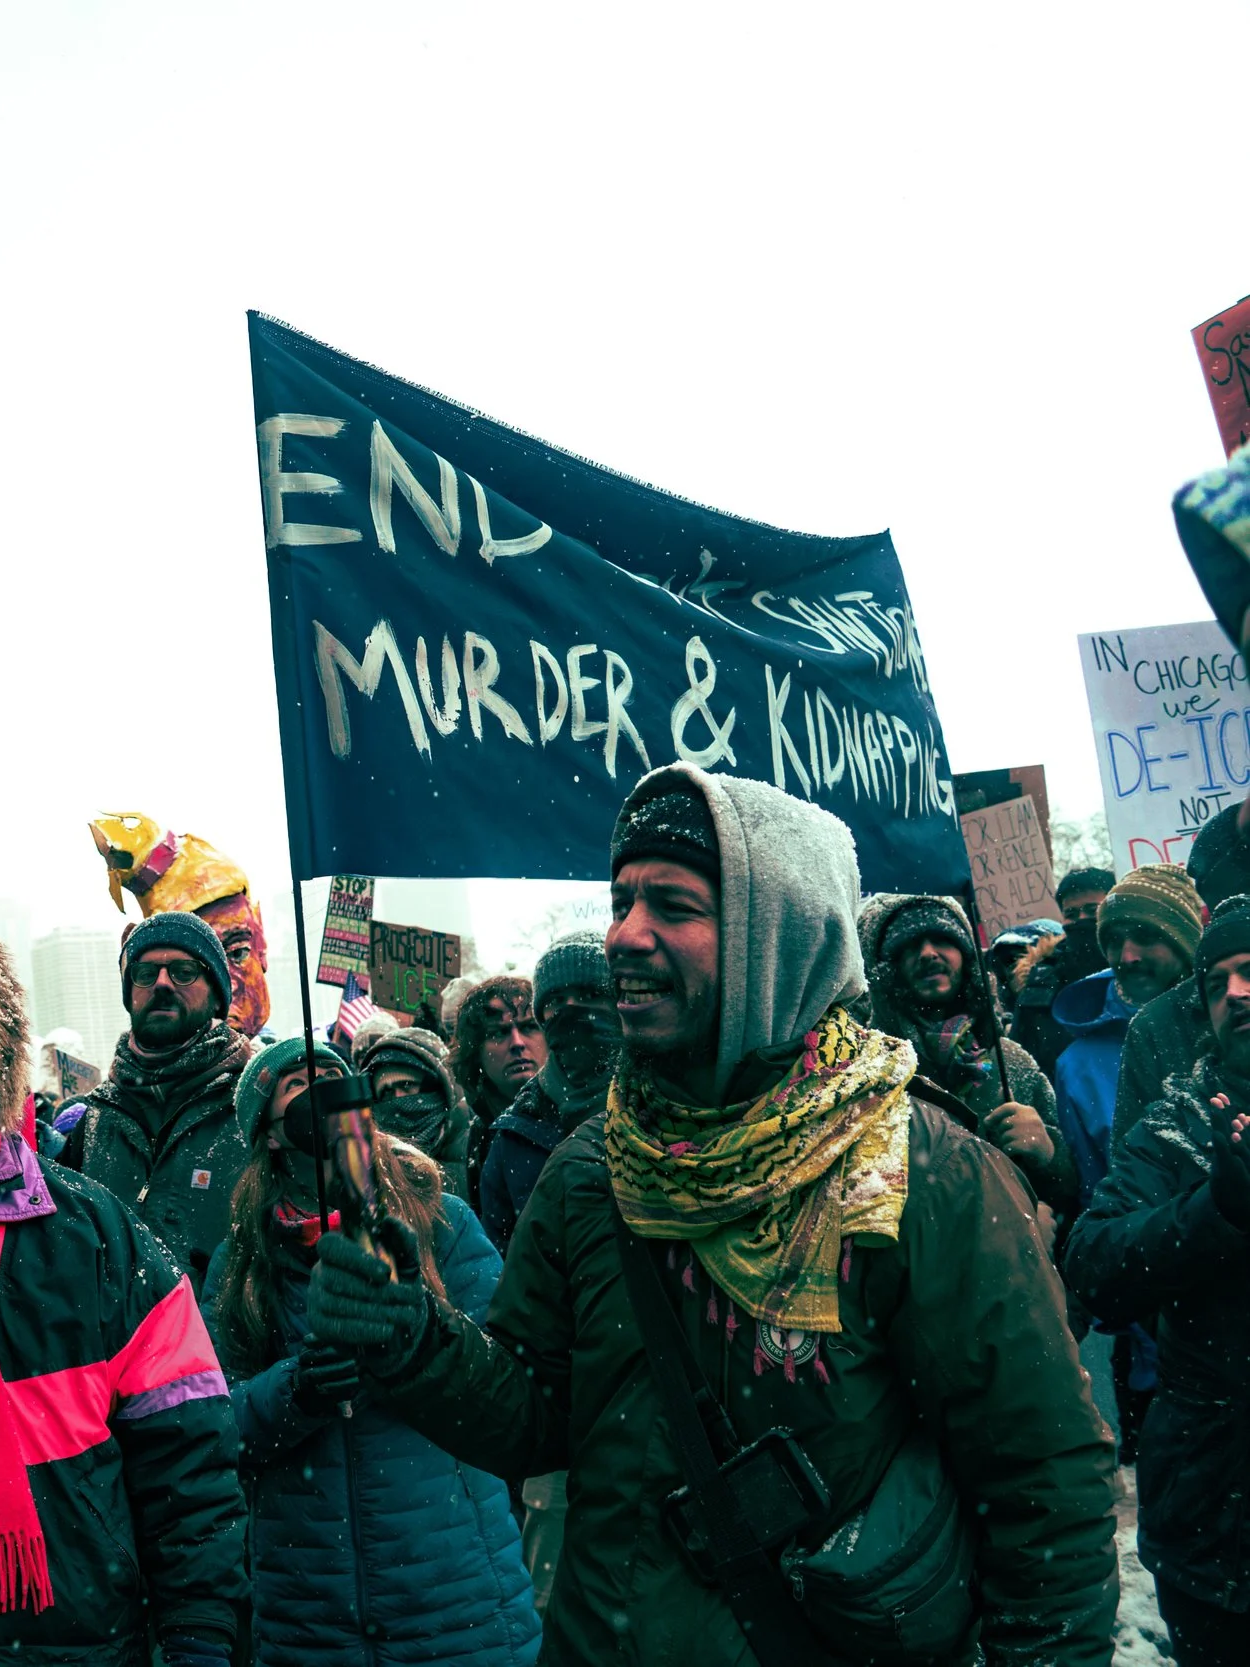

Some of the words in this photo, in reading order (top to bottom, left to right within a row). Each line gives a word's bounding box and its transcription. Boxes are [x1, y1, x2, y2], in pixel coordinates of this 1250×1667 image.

[1091, 635, 1129, 672] IN
[312, 619, 651, 778] MURDER
[670, 635, 736, 769] &
[765, 664, 955, 820] KIDNAPPING
[1106, 708, 1250, 798] DE-IC
[995, 834, 1045, 874] RENEE
[333, 876, 367, 894] STOP
[1009, 868, 1056, 908] ALEX
[370, 921, 456, 978] PROSECUTE
[393, 965, 438, 1011] ICE
